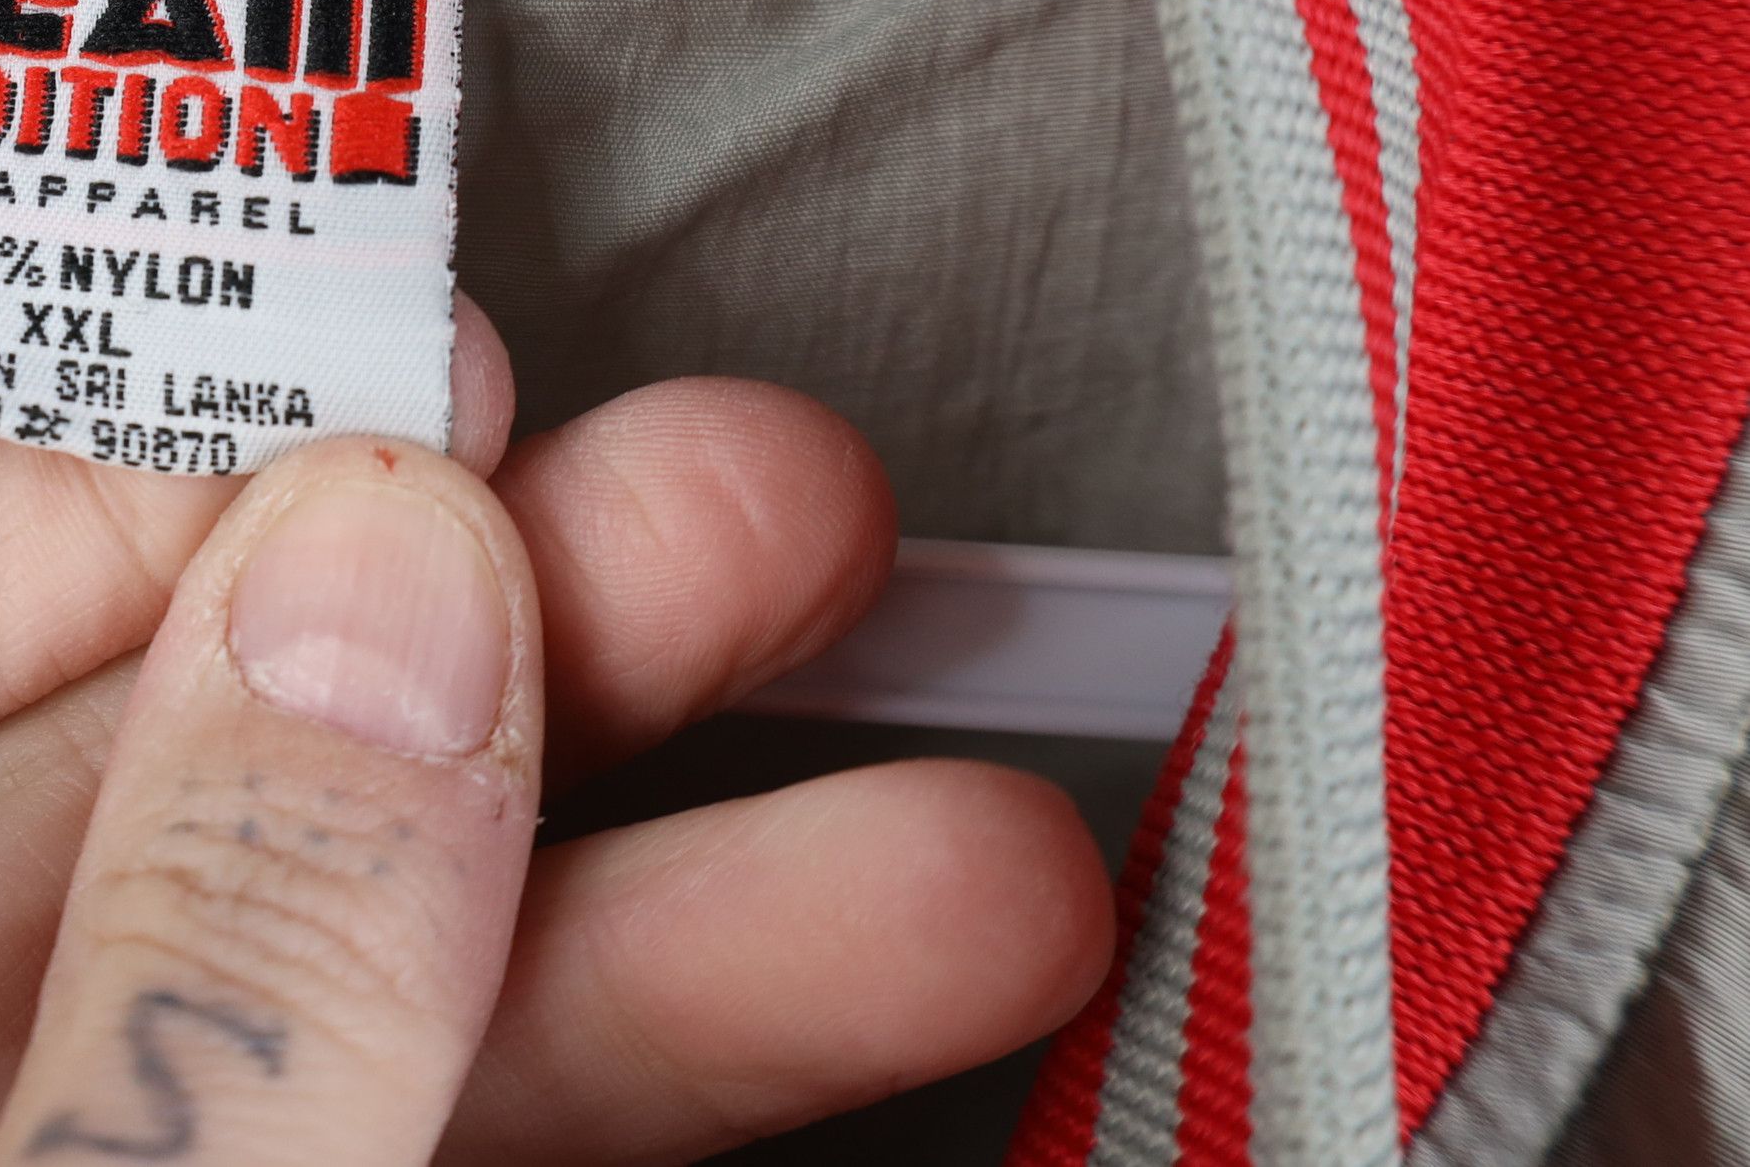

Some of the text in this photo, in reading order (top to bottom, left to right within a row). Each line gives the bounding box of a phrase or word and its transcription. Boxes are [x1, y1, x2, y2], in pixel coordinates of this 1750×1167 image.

[60, 245, 255, 309] NYLON
[20, 302, 131, 357] XXL
[56, 360, 126, 409] SRI
[163, 373, 314, 427] LANKA
[92, 420, 236, 476] 90870
